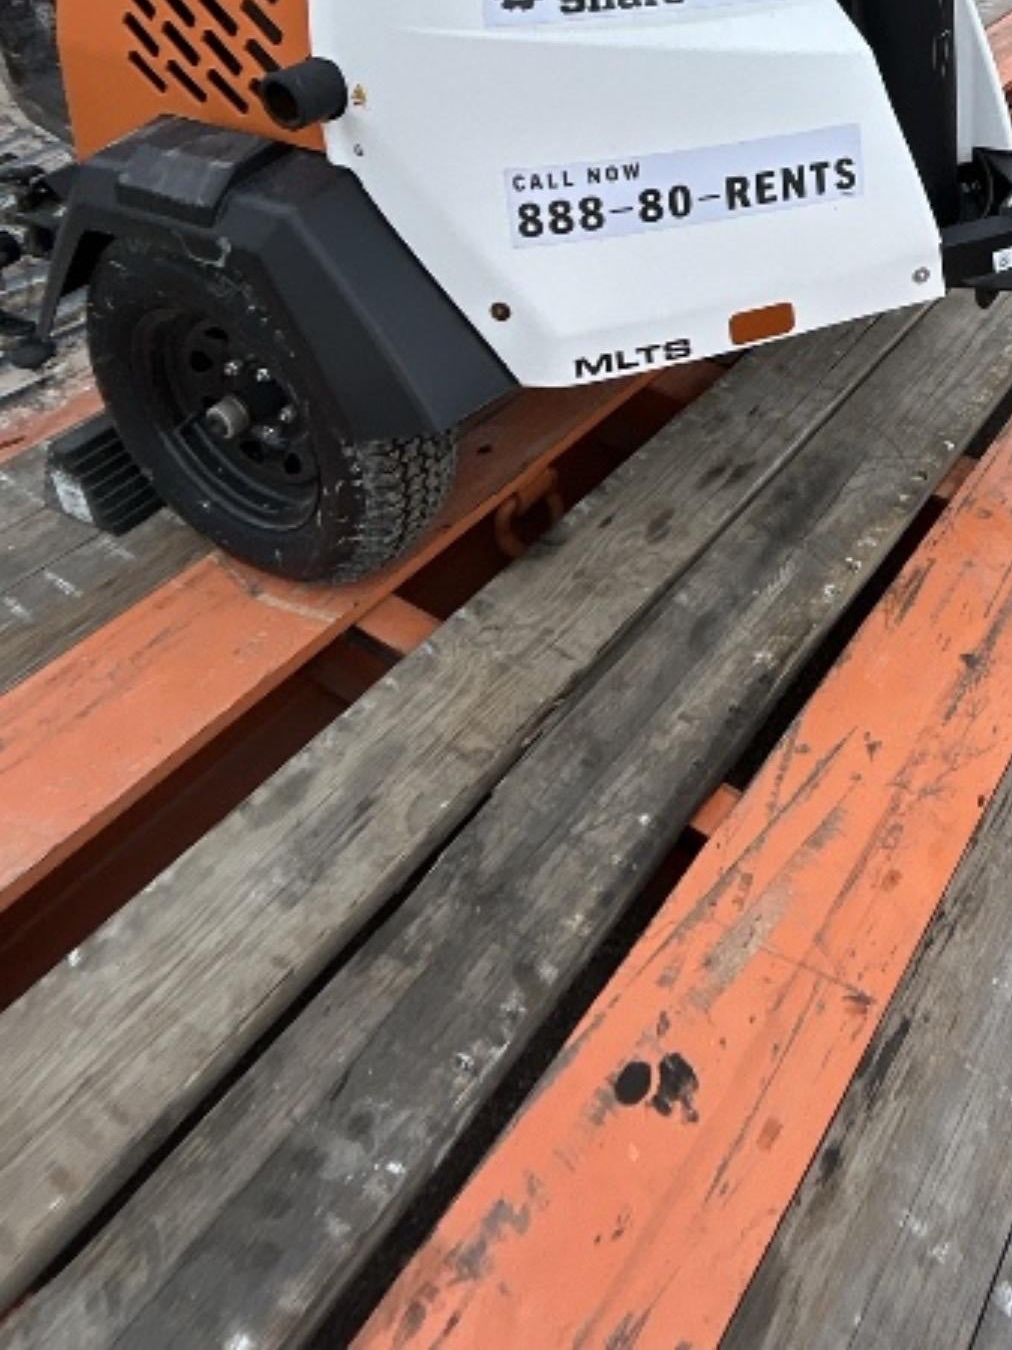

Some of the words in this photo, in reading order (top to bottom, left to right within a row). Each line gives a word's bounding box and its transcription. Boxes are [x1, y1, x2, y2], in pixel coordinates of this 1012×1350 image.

[512, 168, 575, 192] CALL
[586, 161, 641, 184] NOW
[517, 158, 857, 238] 888-80-RENTS
[574, 338, 692, 378] MLTS
